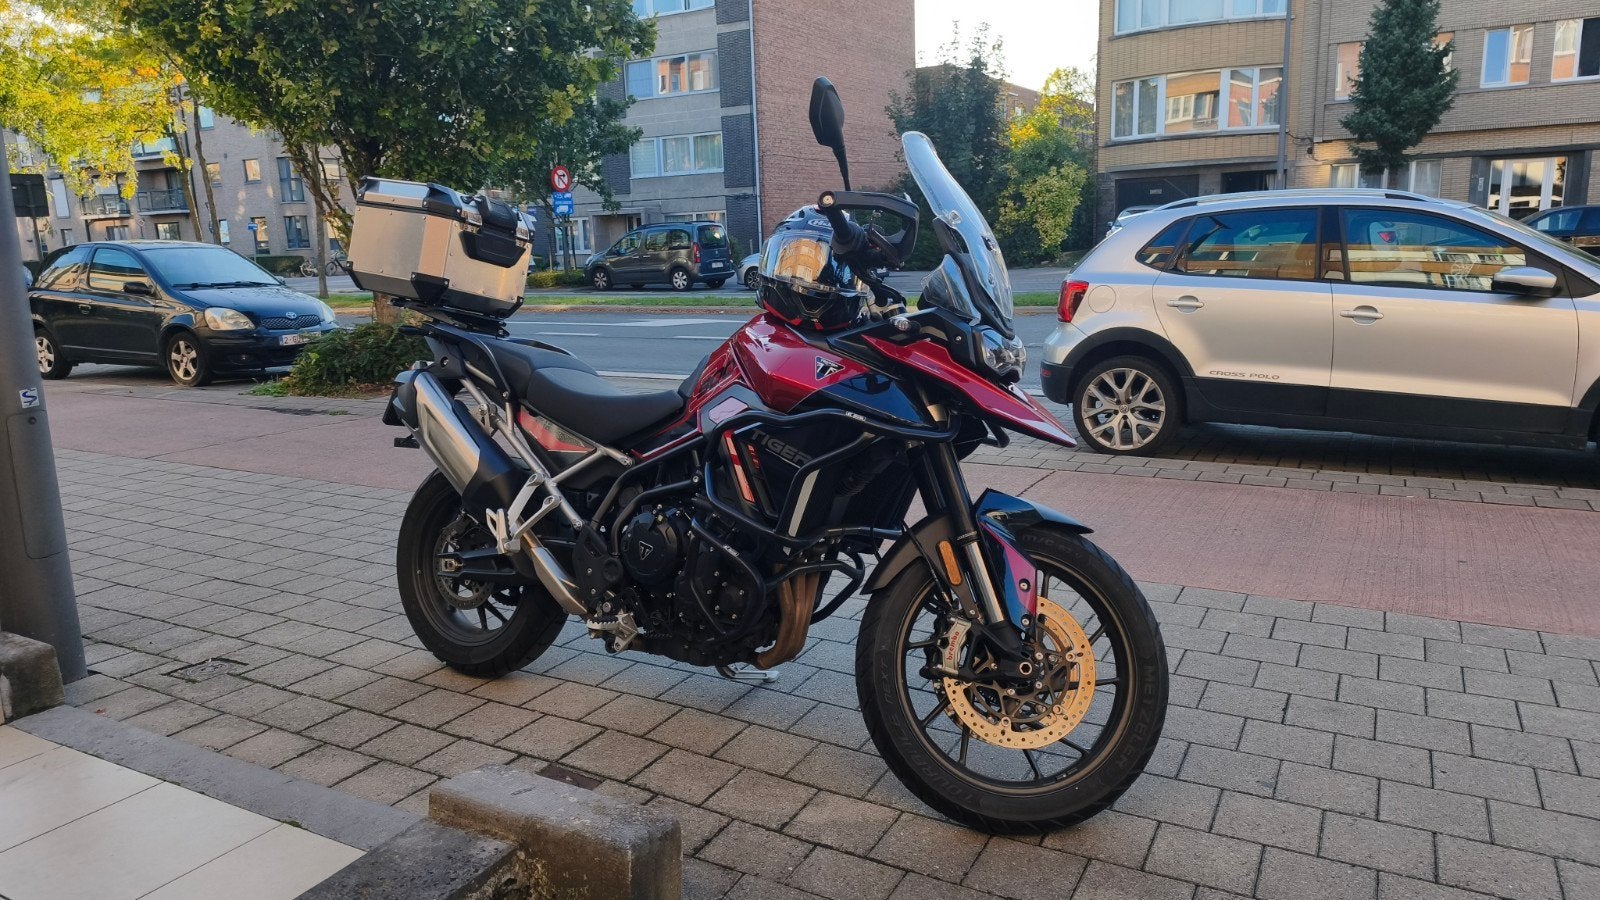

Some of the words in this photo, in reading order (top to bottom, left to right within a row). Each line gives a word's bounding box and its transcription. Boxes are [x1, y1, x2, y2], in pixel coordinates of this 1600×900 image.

[1209, 370, 1246, 378] CROSS
[752, 427, 813, 464] TIGER
[946, 631, 960, 661] brembo
[1114, 665, 1156, 769] METZELER
